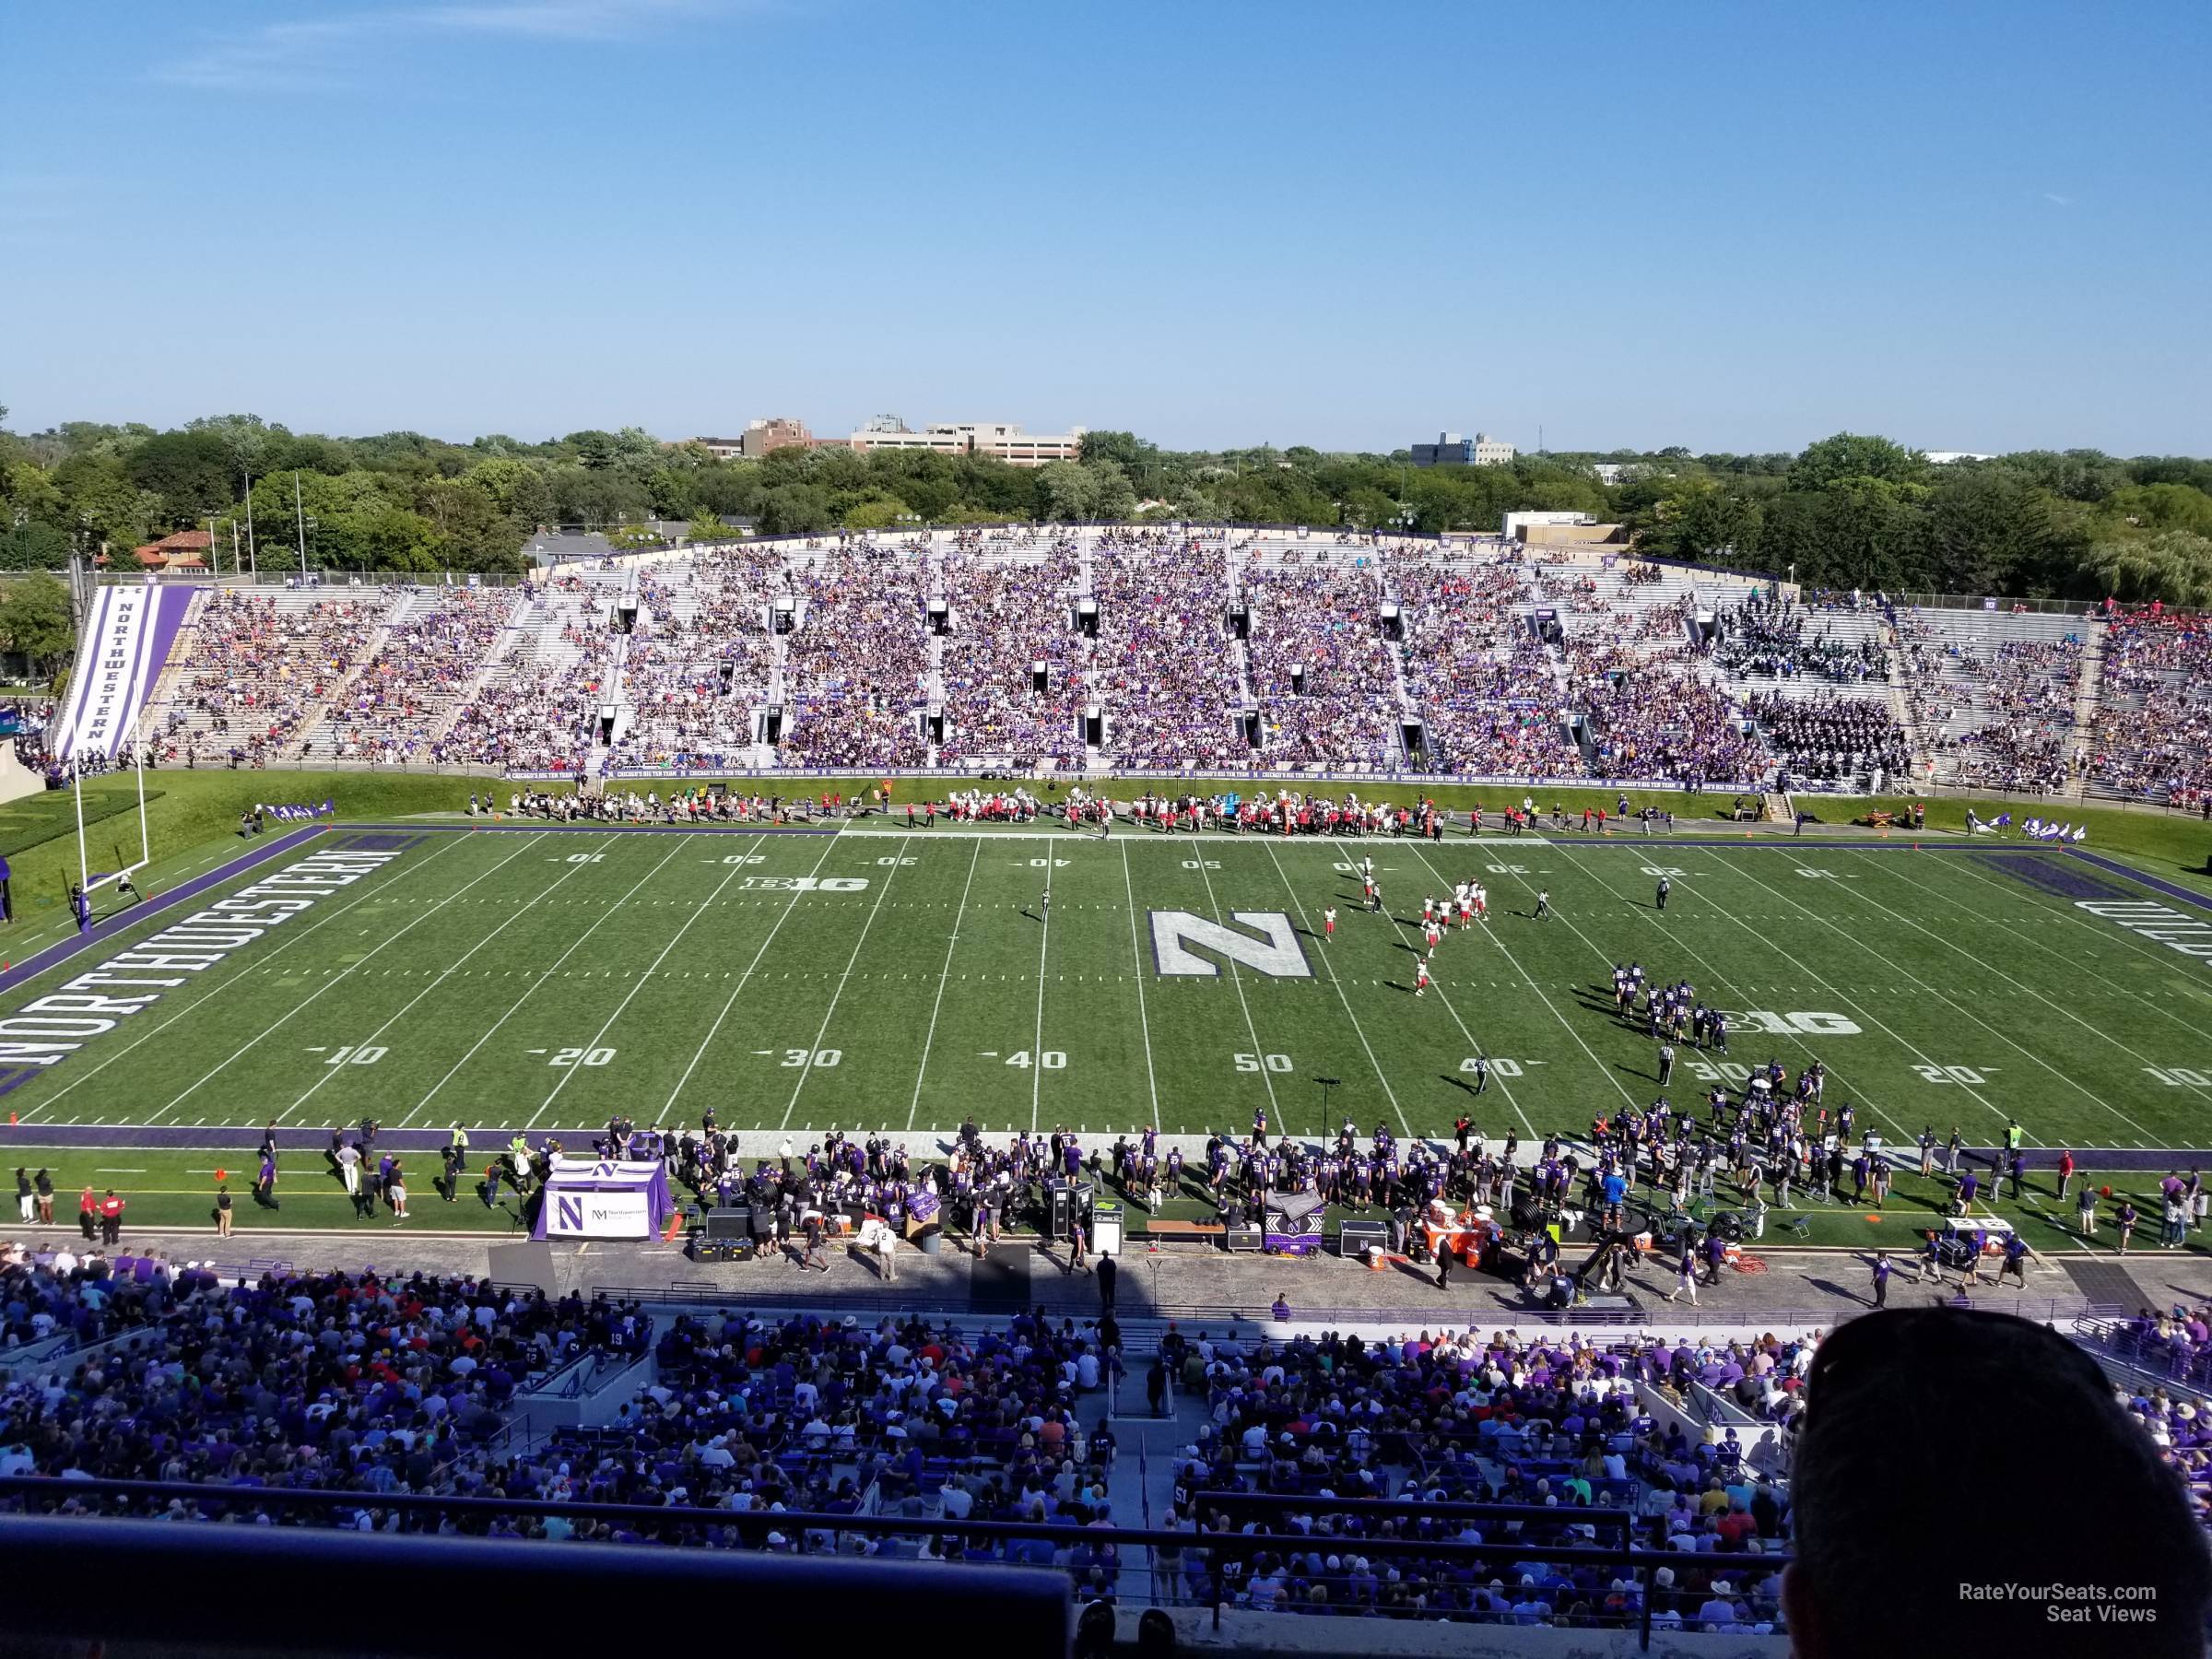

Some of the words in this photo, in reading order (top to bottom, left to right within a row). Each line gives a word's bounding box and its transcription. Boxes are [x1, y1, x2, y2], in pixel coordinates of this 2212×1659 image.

[87, 603, 134, 738] NORTHWESTERN
[566, 853, 606, 863] 10
[722, 855, 766, 864] 20
[877, 857, 917, 865] 30
[1030, 858, 1071, 867] 40
[1182, 860, 1221, 869] 50
[1486, 865, 1531, 874] 30
[1641, 866, 1687, 876] 20
[1149, 910, 1316, 977] N
[324, 1046, 388, 1065] 10
[548, 1048, 617, 1066] 20
[780, 1049, 842, 1067] 30
[1006, 1050, 1067, 1069] 40
[1233, 1053, 1293, 1072] 50
[1459, 1057, 1524, 1077] 40
[1684, 1063, 1751, 1080] 30
[1910, 1065, 1986, 1084] 20
[2140, 1067, 2212, 1086] 10
[1036, 1147, 1044, 1156] 16
[592, 1163, 618, 1177] N
[1269, 1161, 1277, 1170] 17
[1386, 1164, 1395, 1172] 75
[1536, 1171, 1546, 1180] 63
[559, 1196, 582, 1231] N
[881, 1232, 887, 1241] 2
[1359, 1240, 1369, 1251] N
[611, 1334, 623, 1345] 19
[843, 1377, 855, 1389] 94
[1174, 1487, 1188, 1504] 51
[1222, 1561, 1242, 1580] 97
